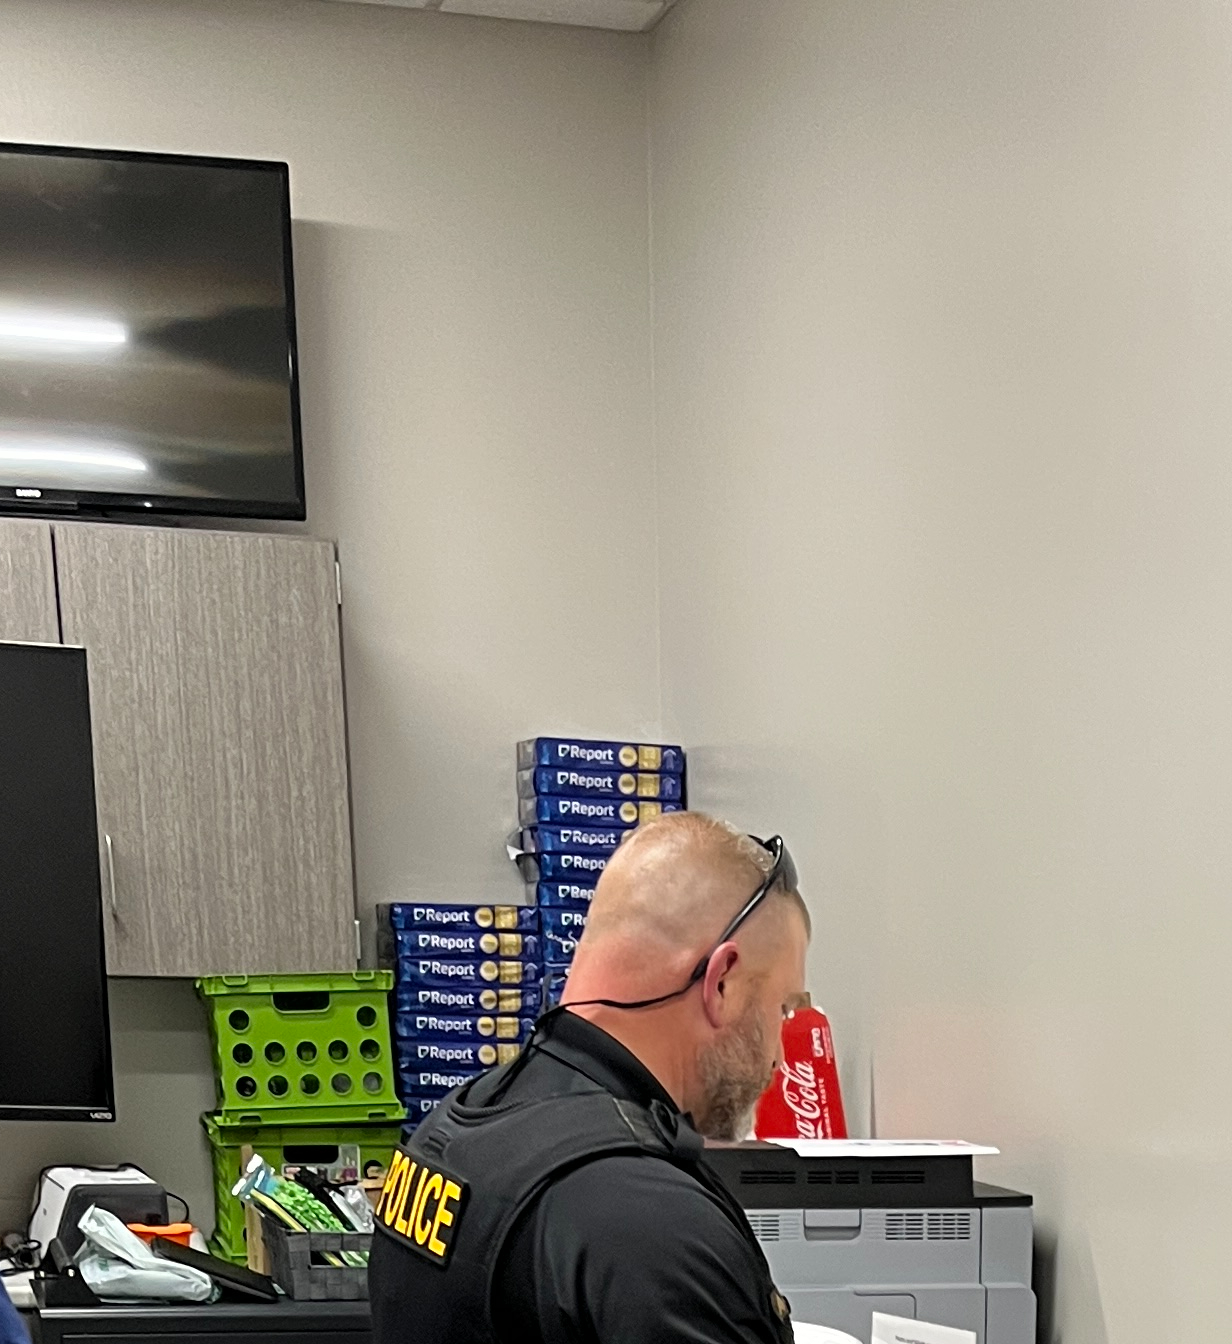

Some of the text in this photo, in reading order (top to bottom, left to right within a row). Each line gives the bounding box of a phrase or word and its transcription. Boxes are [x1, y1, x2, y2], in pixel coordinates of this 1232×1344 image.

[570, 745, 614, 761] Report
[569, 773, 613, 789] Report
[571, 801, 615, 817] Report
[572, 830, 616, 845] Report
[573, 855, 606, 871] Repo
[570, 886, 596, 900] Rep
[426, 908, 470, 923] Report
[431, 935, 475, 950] Report
[431, 961, 475, 977] Report
[431, 991, 474, 1005] Report
[428, 1017, 472, 1032] Report
[430, 1046, 473, 1061] Report
[780, 1060, 821, 1139] a-Cola
[376, 1149, 461, 1257] POLICE
